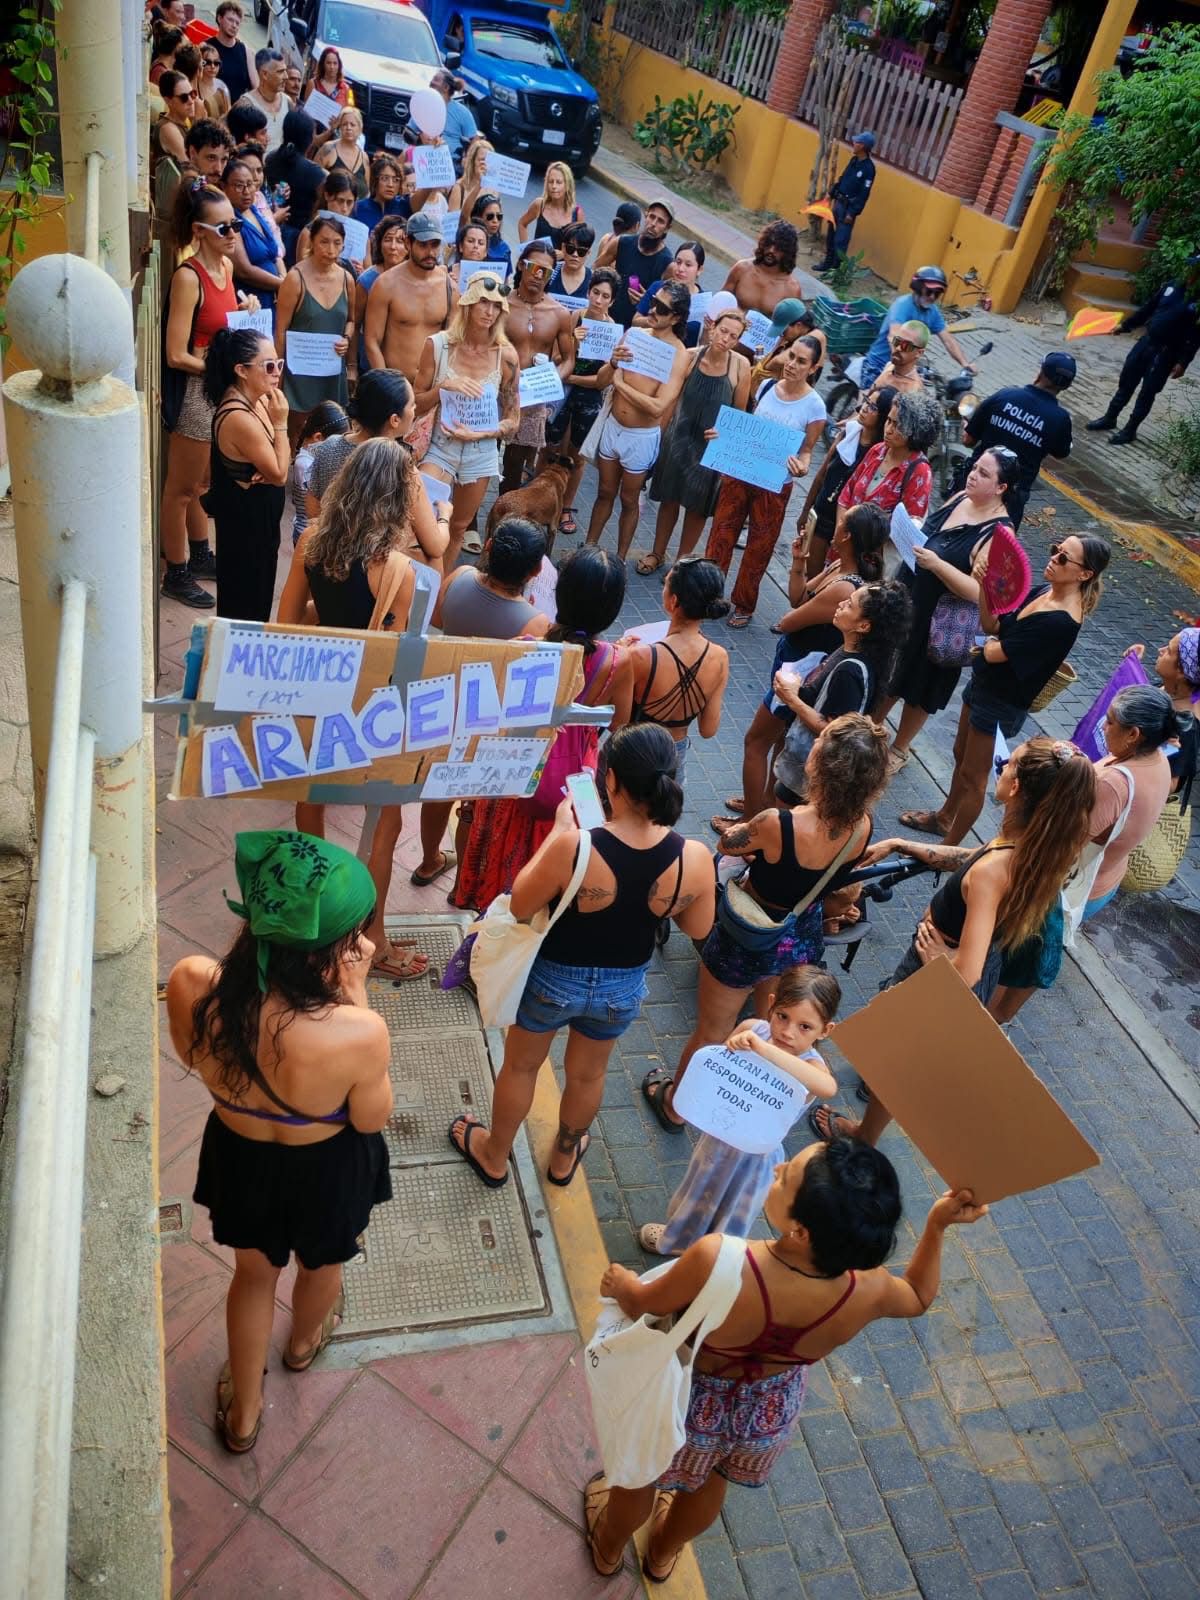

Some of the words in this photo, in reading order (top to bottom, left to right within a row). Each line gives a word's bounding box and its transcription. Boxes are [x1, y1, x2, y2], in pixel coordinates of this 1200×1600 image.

[990, 414, 1043, 447] MUNICIPAL
[1003, 402, 1044, 431] POLICÍA
[226, 643, 356, 682] MARCHAMOS
[210, 661, 555, 794] ARACELI
[477, 747, 534, 762] TODAS
[433, 764, 472, 782] QUE
[479, 765, 501, 784] YA
[505, 765, 532, 781] NO
[446, 782, 507, 797] ESTAN
[703, 1057, 785, 1110] RESPONDEMOS
[719, 1048, 762, 1077] ATACAN
[760, 1072, 771, 1083] A
[770, 1077, 794, 1098] UNA
[716, 1085, 753, 1113] TODAS
